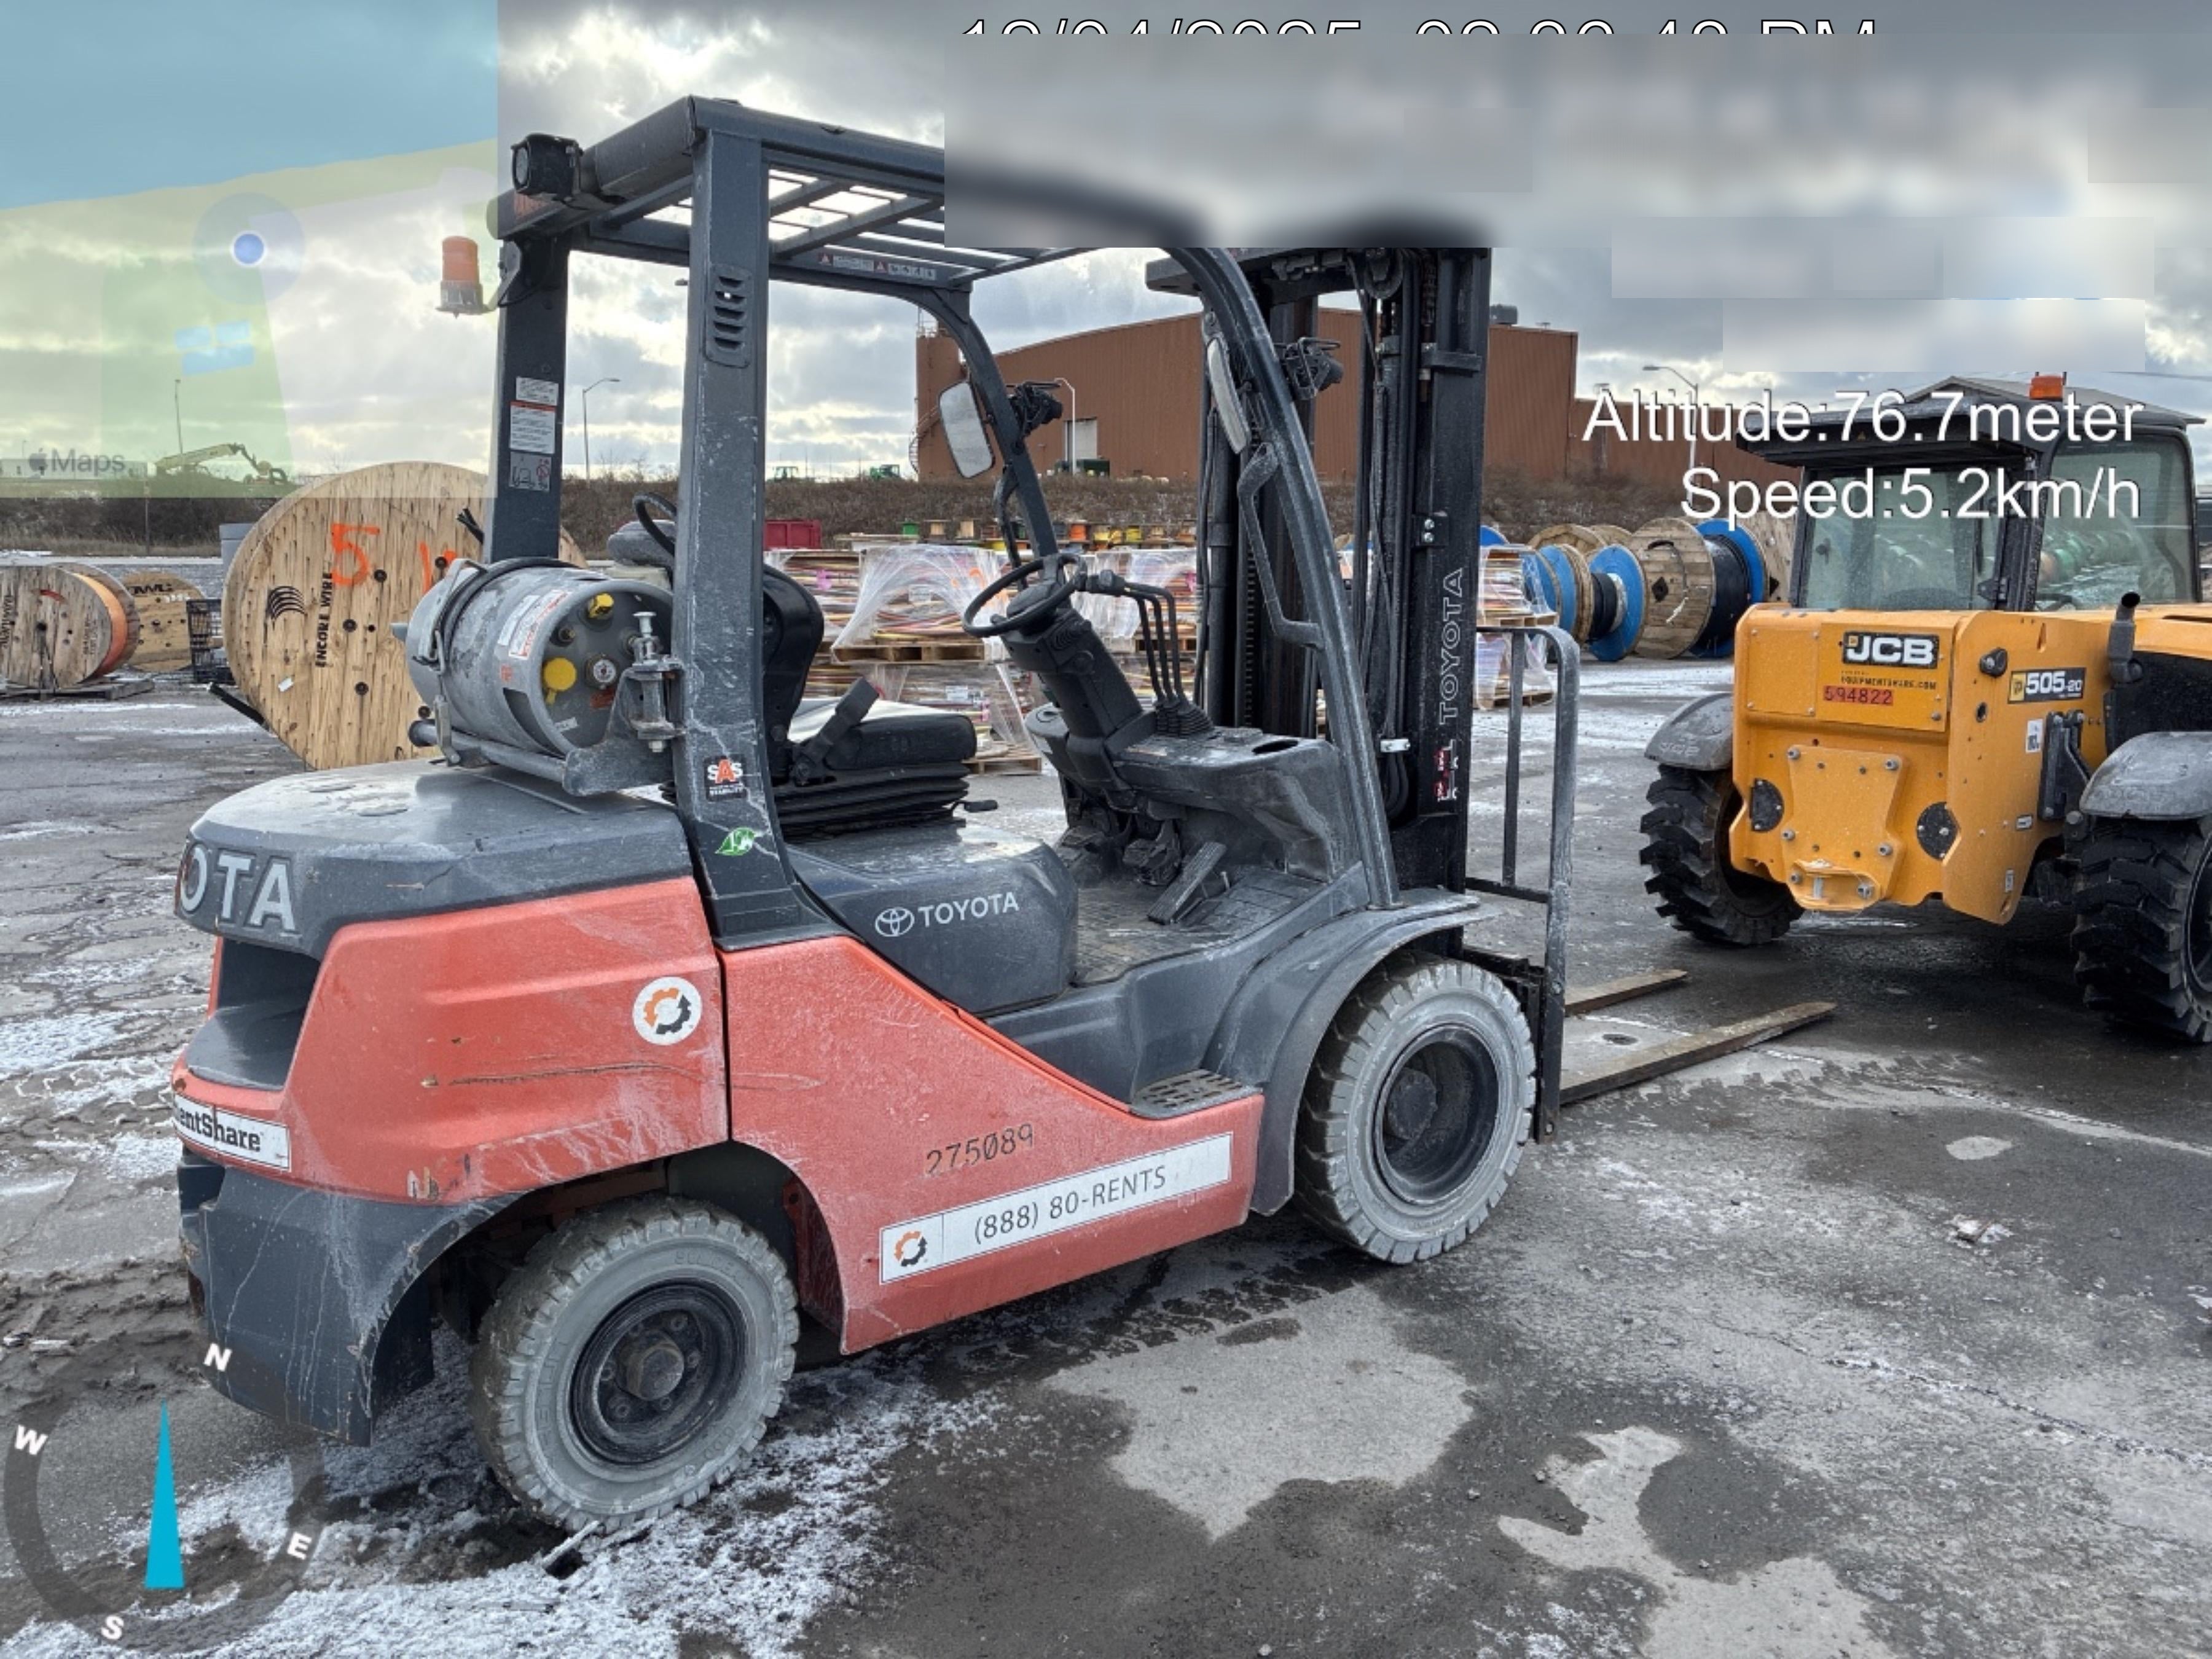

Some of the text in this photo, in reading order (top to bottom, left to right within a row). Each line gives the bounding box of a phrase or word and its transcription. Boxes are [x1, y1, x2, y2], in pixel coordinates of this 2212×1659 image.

[331, 523, 380, 586] 5
[315, 573, 333, 667] ENCORE WIRE
[1439, 567, 1463, 725] TOYOTA
[1845, 635, 1934, 665] JCB
[1824, 686, 1892, 705] 594822
[918, 892, 1019, 927] TOYOTA
[926, 1123, 1034, 1174] 275089
[974, 1165, 1166, 1245] (888) 80-RENTS
